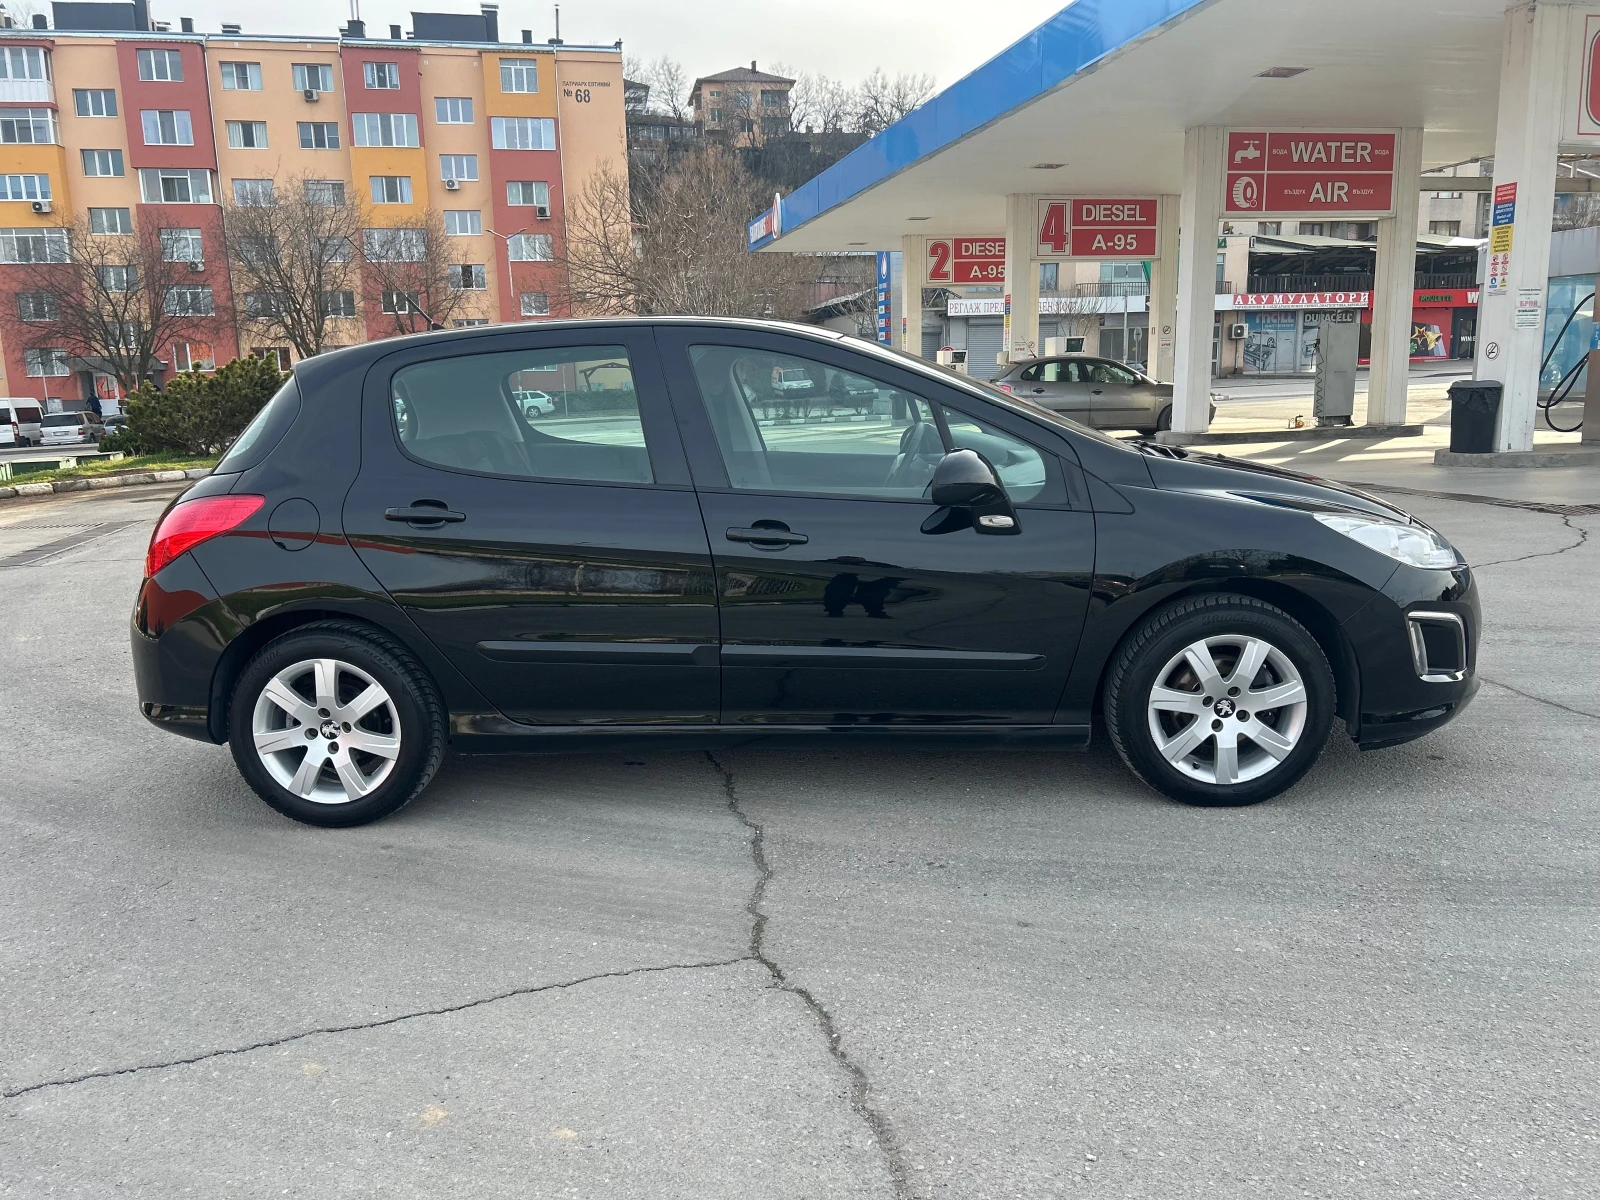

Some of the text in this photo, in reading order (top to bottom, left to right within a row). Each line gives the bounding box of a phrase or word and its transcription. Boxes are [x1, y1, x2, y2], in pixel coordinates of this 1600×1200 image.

[575, 89, 591, 103] 68
[1290, 141, 1372, 163] WATER
[1308, 181, 1349, 203] AIR
[1082, 204, 1147, 221] DIESEL
[1040, 203, 1069, 253] 4
[961, 242, 1005, 256] DIESE
[1091, 234, 1137, 250] A-95
[929, 241, 950, 280] 2
[969, 265, 1005, 278] A-95
[1234, 292, 1369, 305] АКУМУЛАТОРИ
[949, 302, 1005, 314] РЕГЛАЖ ПРЕД
[1304, 313, 1352, 323] DURACELL
[1202, 613, 1281, 633] BRIDGESTONE
